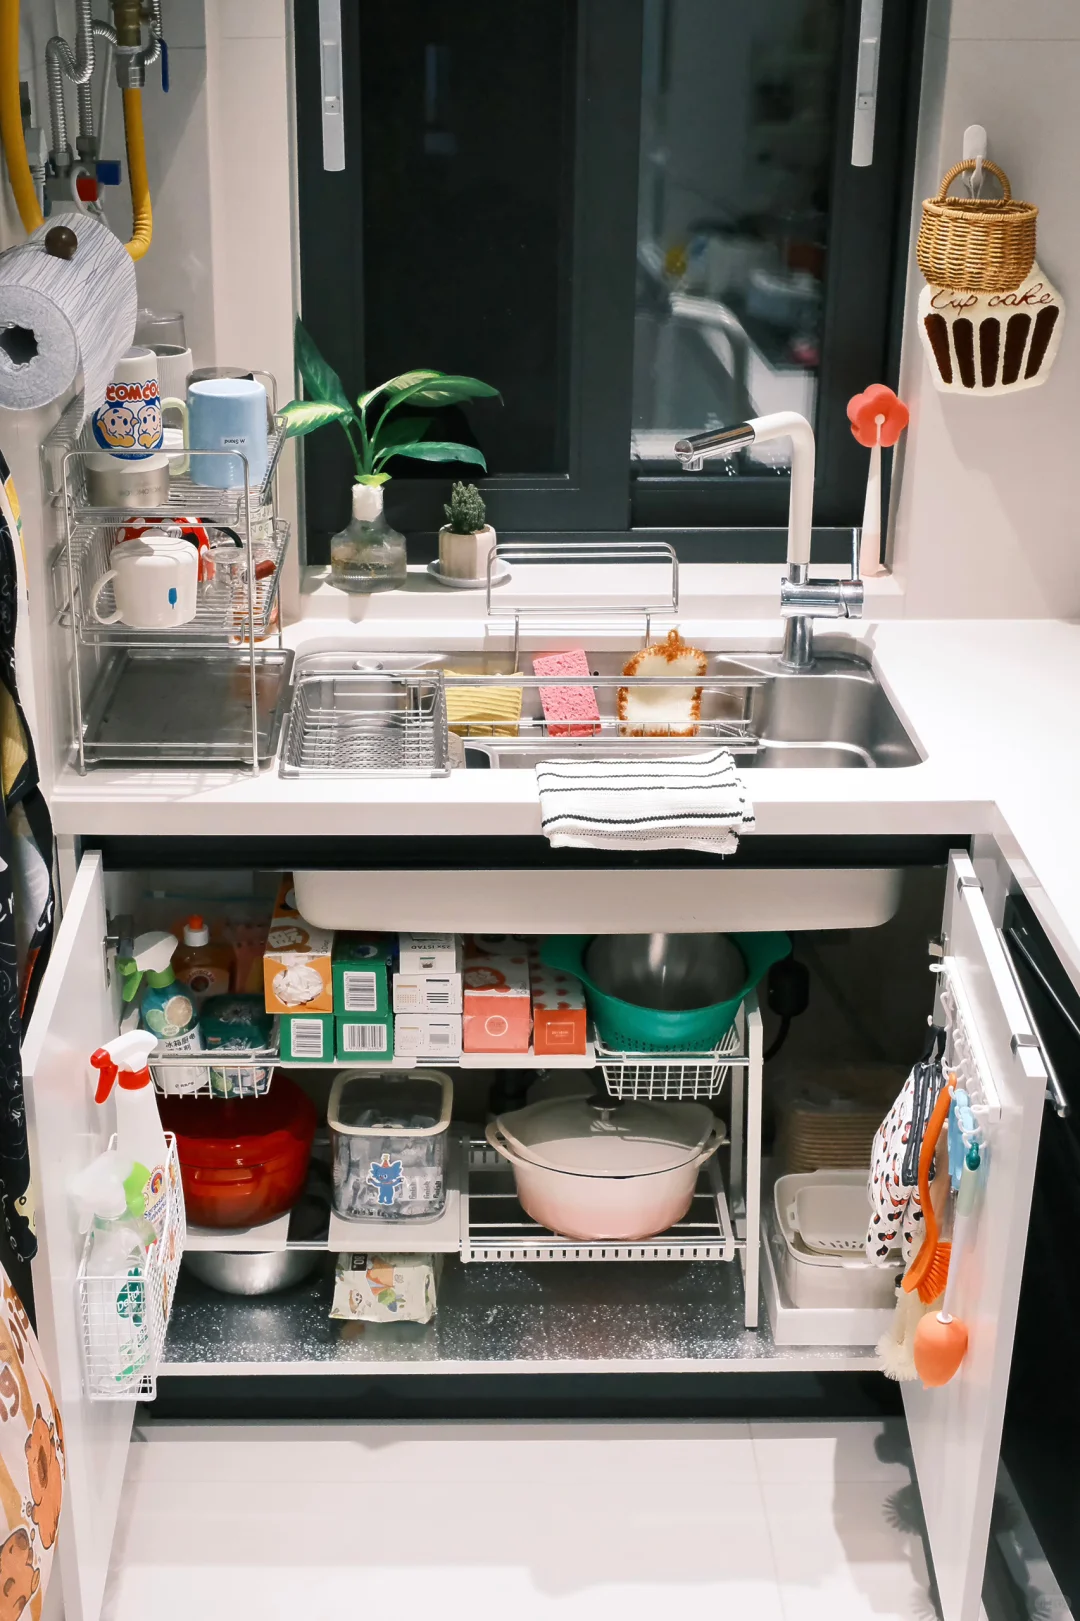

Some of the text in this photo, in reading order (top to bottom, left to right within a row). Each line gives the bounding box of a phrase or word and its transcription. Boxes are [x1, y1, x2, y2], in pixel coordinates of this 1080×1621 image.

[931, 283, 1054, 316] Cup cake
[165, 1033, 196, 1048] 冰箱厨电
[408, 1182, 417, 1199] finish
[422, 1181, 431, 1199] finish
[433, 1181, 442, 1198] finish
